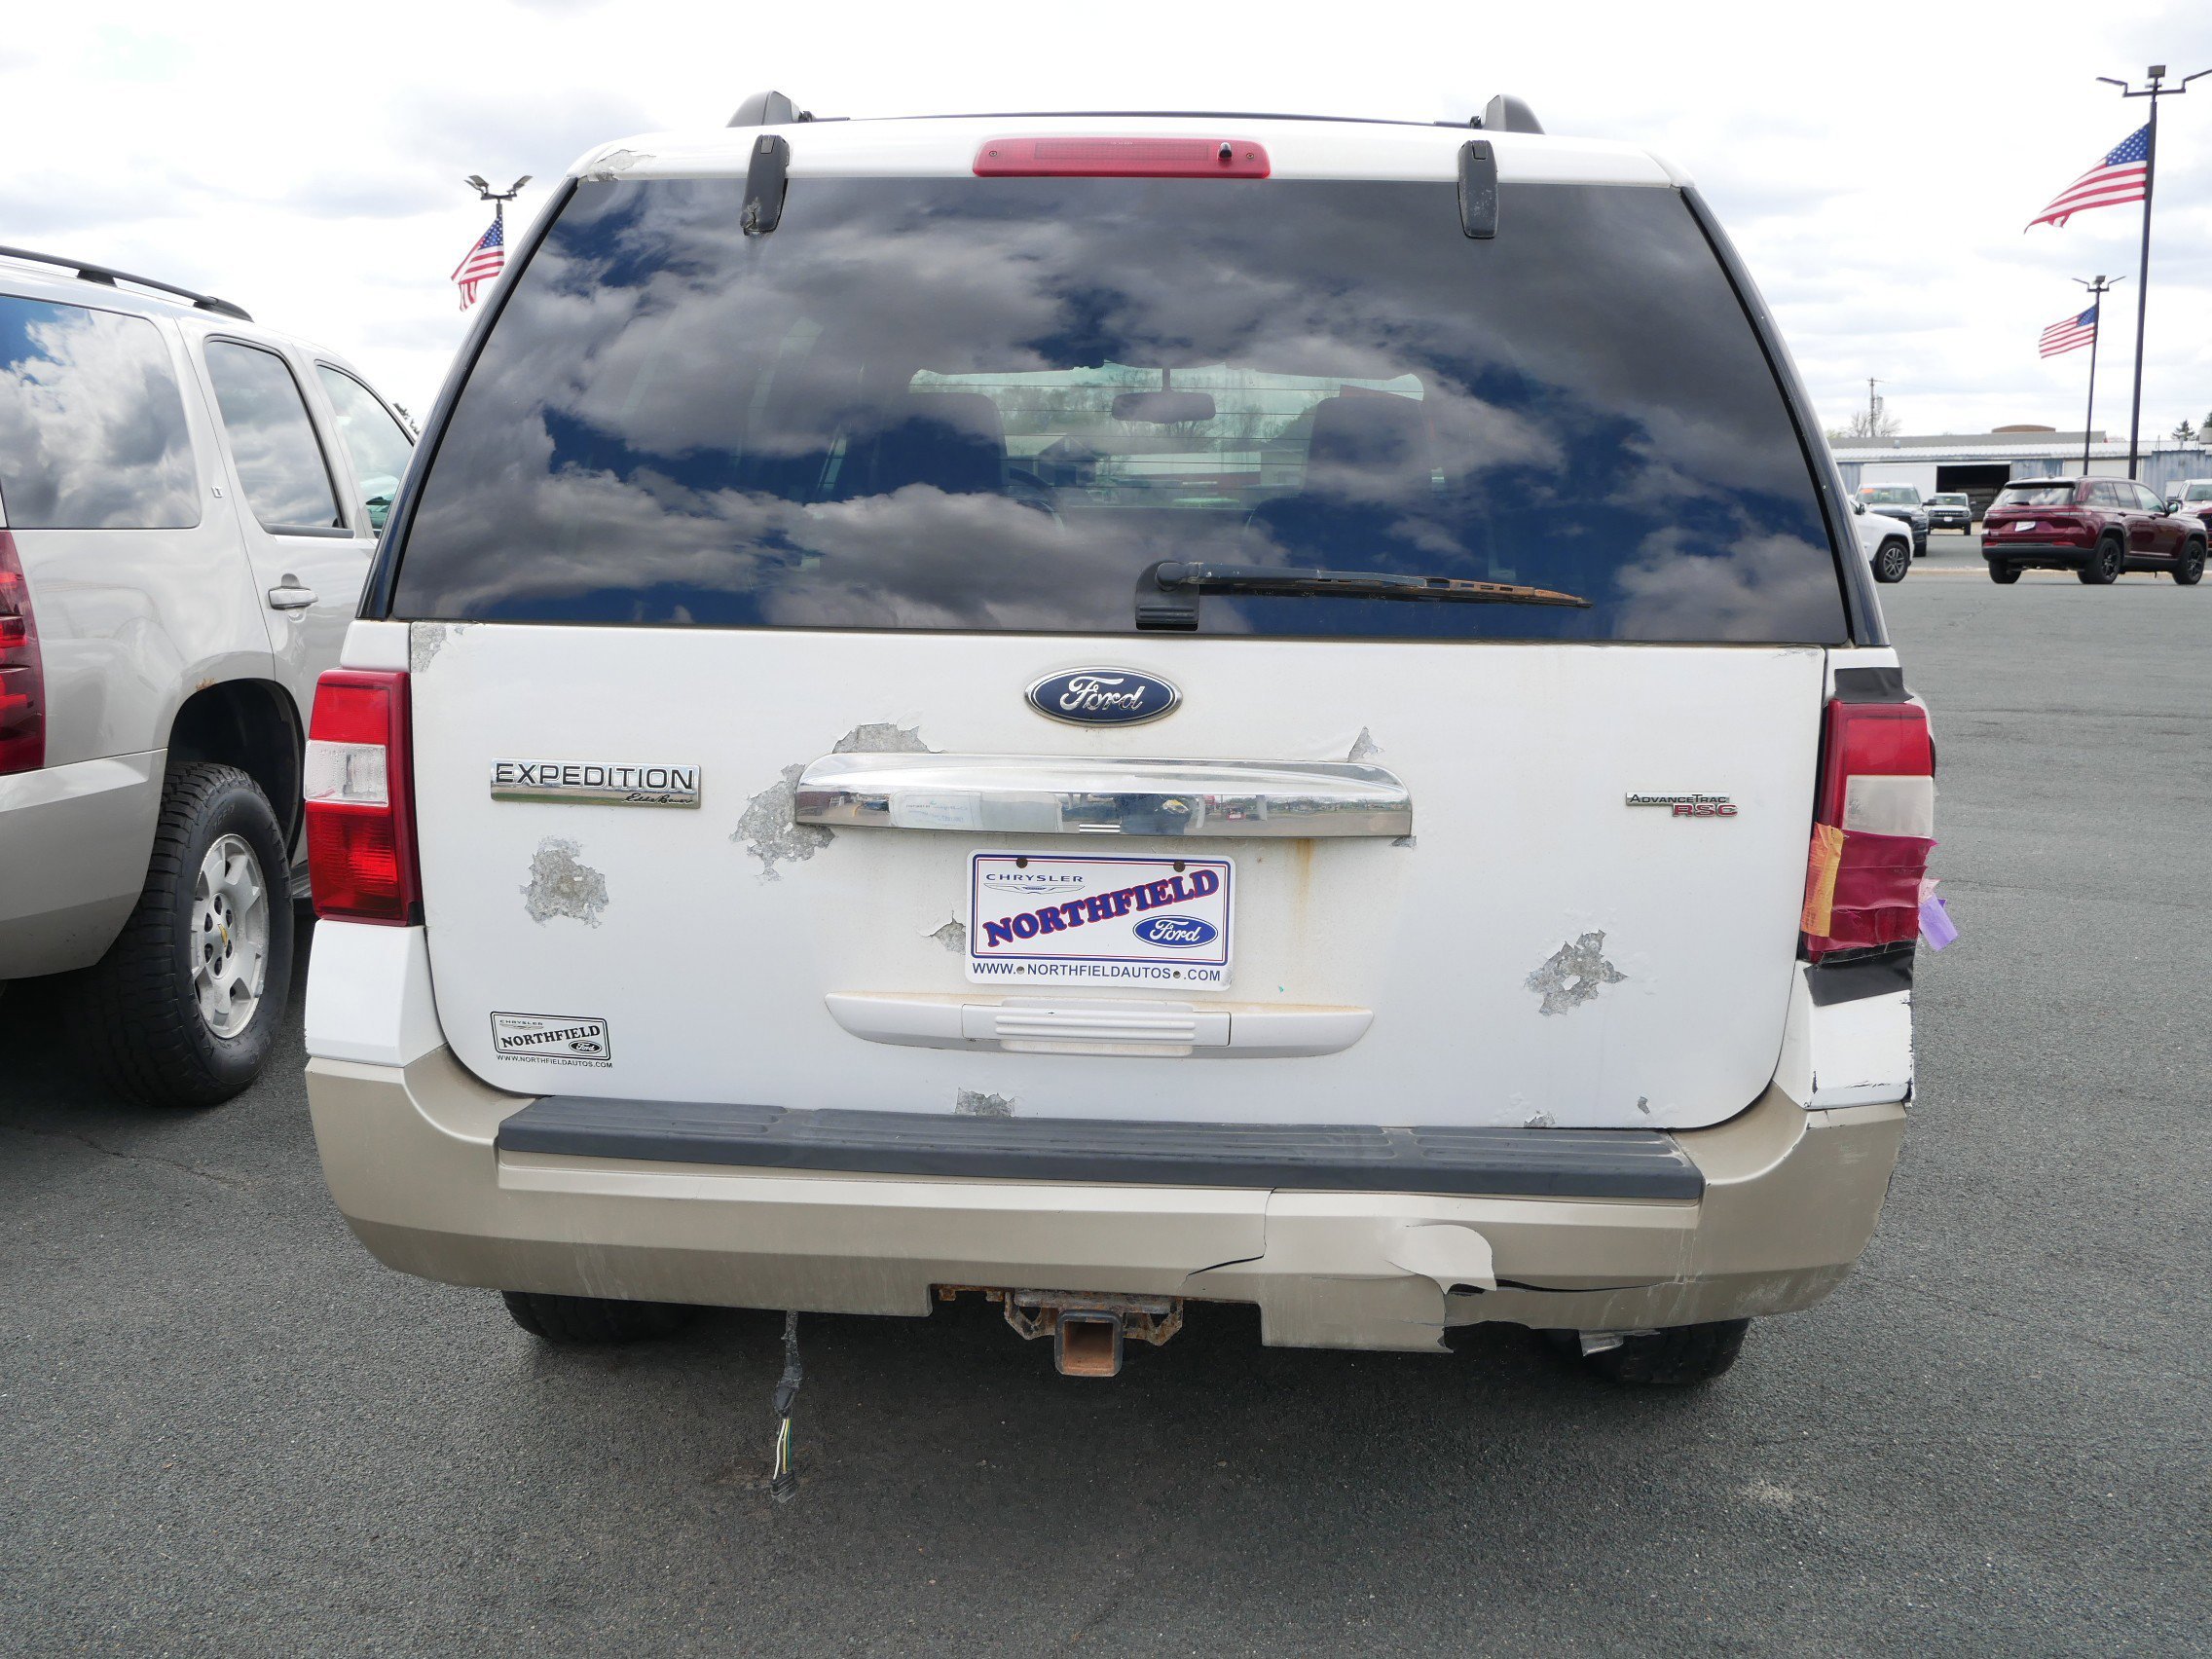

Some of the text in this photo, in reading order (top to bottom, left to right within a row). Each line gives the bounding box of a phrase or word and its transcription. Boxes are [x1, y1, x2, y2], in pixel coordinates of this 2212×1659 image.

[1059, 676, 1146, 711] Ford
[496, 762, 694, 790] EXPEDITION
[1673, 803, 1738, 818] RSC
[985, 872, 1085, 883] CHRYSLER
[982, 868, 1221, 948] NORTHFIELD
[1149, 919, 1202, 943] Ford
[500, 1025, 601, 1049] NORTHFIELD
[575, 1042, 596, 1052] Ford
[497, 1054, 613, 1069] WWW.NORTHFIELDAUTOS.COM
